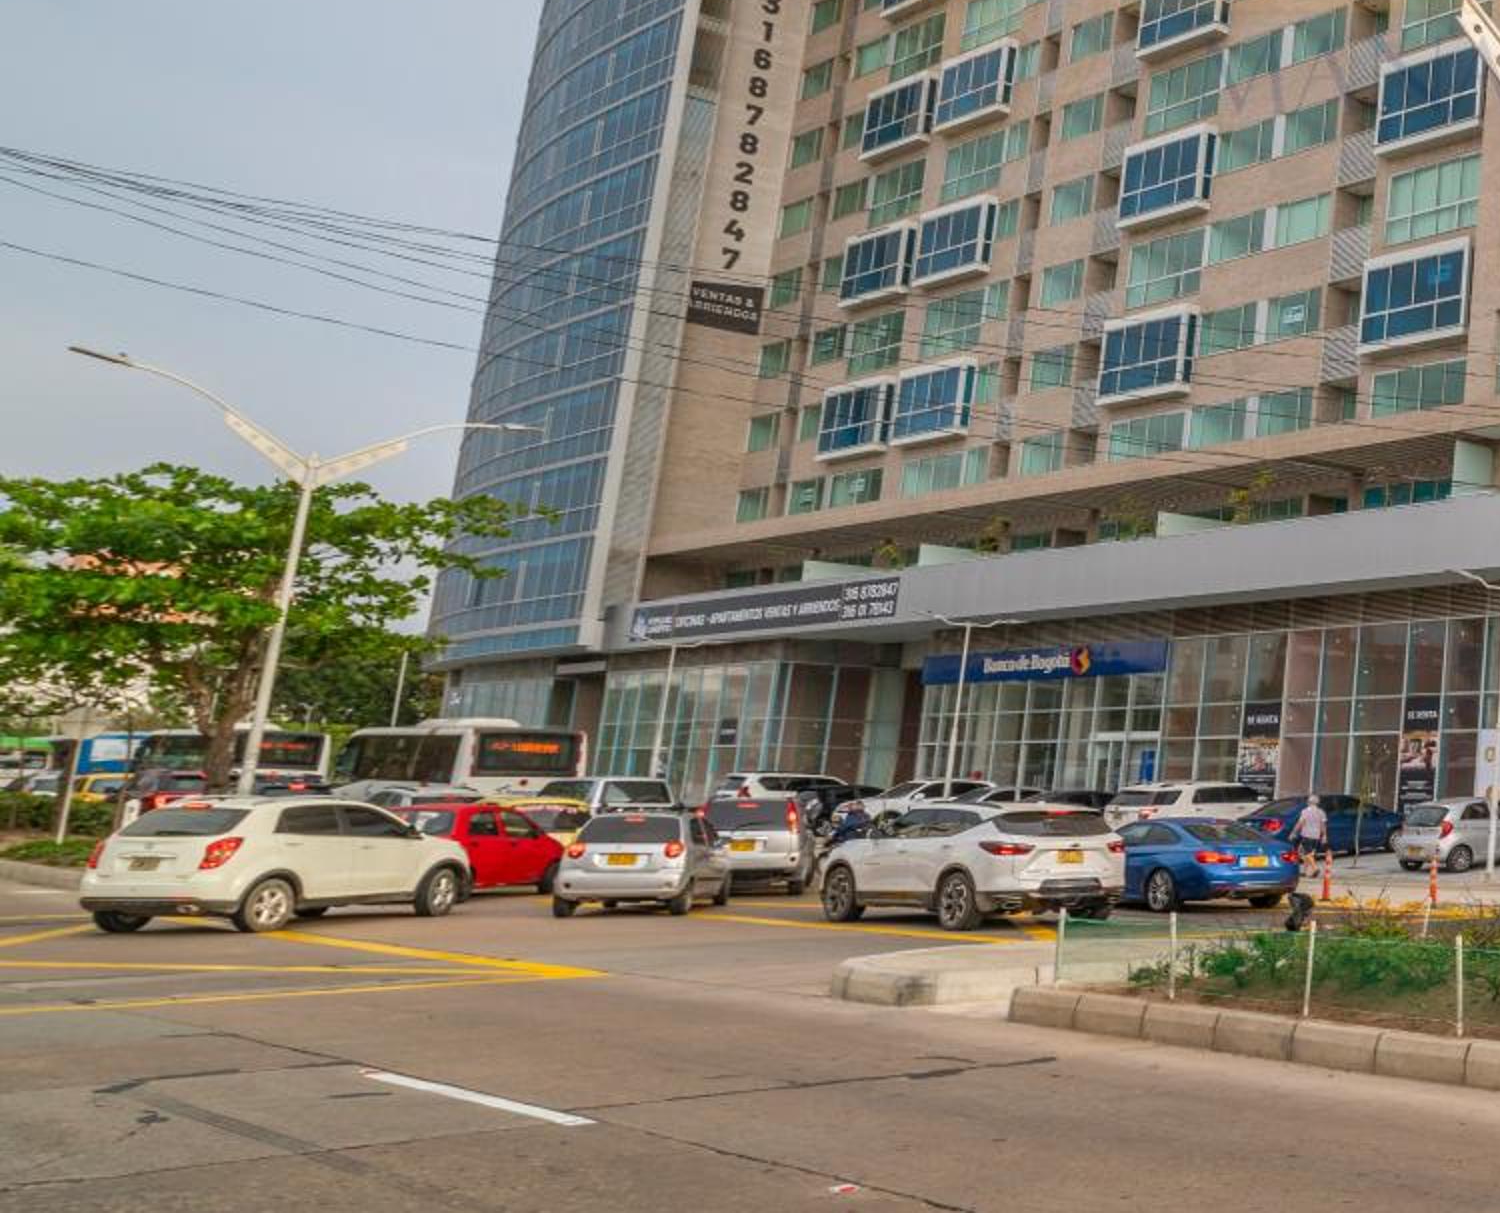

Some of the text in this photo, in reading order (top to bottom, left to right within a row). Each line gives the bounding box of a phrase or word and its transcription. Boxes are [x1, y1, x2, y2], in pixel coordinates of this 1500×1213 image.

[693, 288, 742, 307] VENTAS
[983, 657, 1017, 674] Banco
[1418, 709, 1438, 719] RENTA
